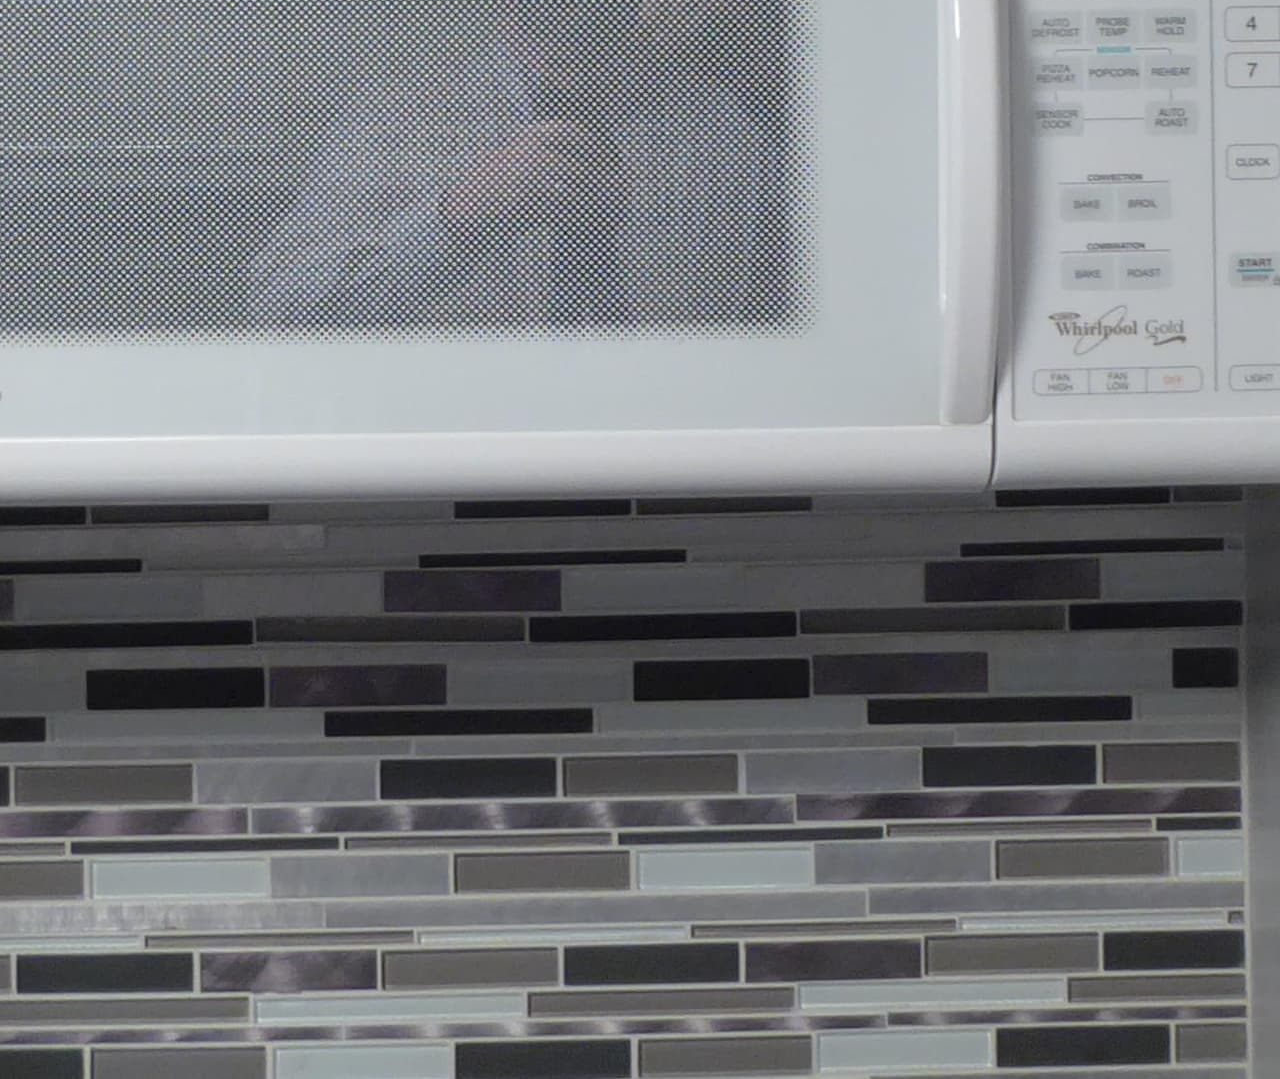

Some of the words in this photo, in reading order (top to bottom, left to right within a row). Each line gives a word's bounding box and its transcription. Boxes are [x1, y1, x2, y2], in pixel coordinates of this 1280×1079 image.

[1042, 18, 1070, 27] AUTO
[1096, 17, 1129, 26] PROBE
[1154, 17, 1187, 25] WARM
[1246, 16, 1257, 30] 4
[1032, 28, 1080, 37] DEFROST
[1099, 27, 1128, 36] TEMP
[1156, 27, 1185, 35] HOLD
[1042, 65, 1070, 73] PIZZA
[1089, 68, 1139, 77] POPCORN
[1151, 67, 1190, 75] REHEAT
[1247, 63, 1258, 77] 7
[1036, 74, 1076, 82] REHEAT
[1035, 110, 1078, 119] SENSOR
[1158, 108, 1185, 117] AUTO
[1042, 120, 1071, 128] COOK
[1155, 118, 1188, 127] ROAST
[1236, 157, 1270, 167] CLOCK
[1073, 200, 1101, 209] BAKE
[1128, 199, 1157, 208] BROIL
[1238, 258, 1272, 267] START
[1074, 270, 1101, 279] BAKE
[1127, 269, 1160, 277] ROAST
[1055, 320, 1138, 338] Whirlpool
[1145, 320, 1184, 334] Gold
[1050, 374, 1070, 382] FAN
[1107, 373, 1128, 381] FAN
[1244, 374, 1273, 383] LIGHT
[1107, 382, 1128, 391] LOW
